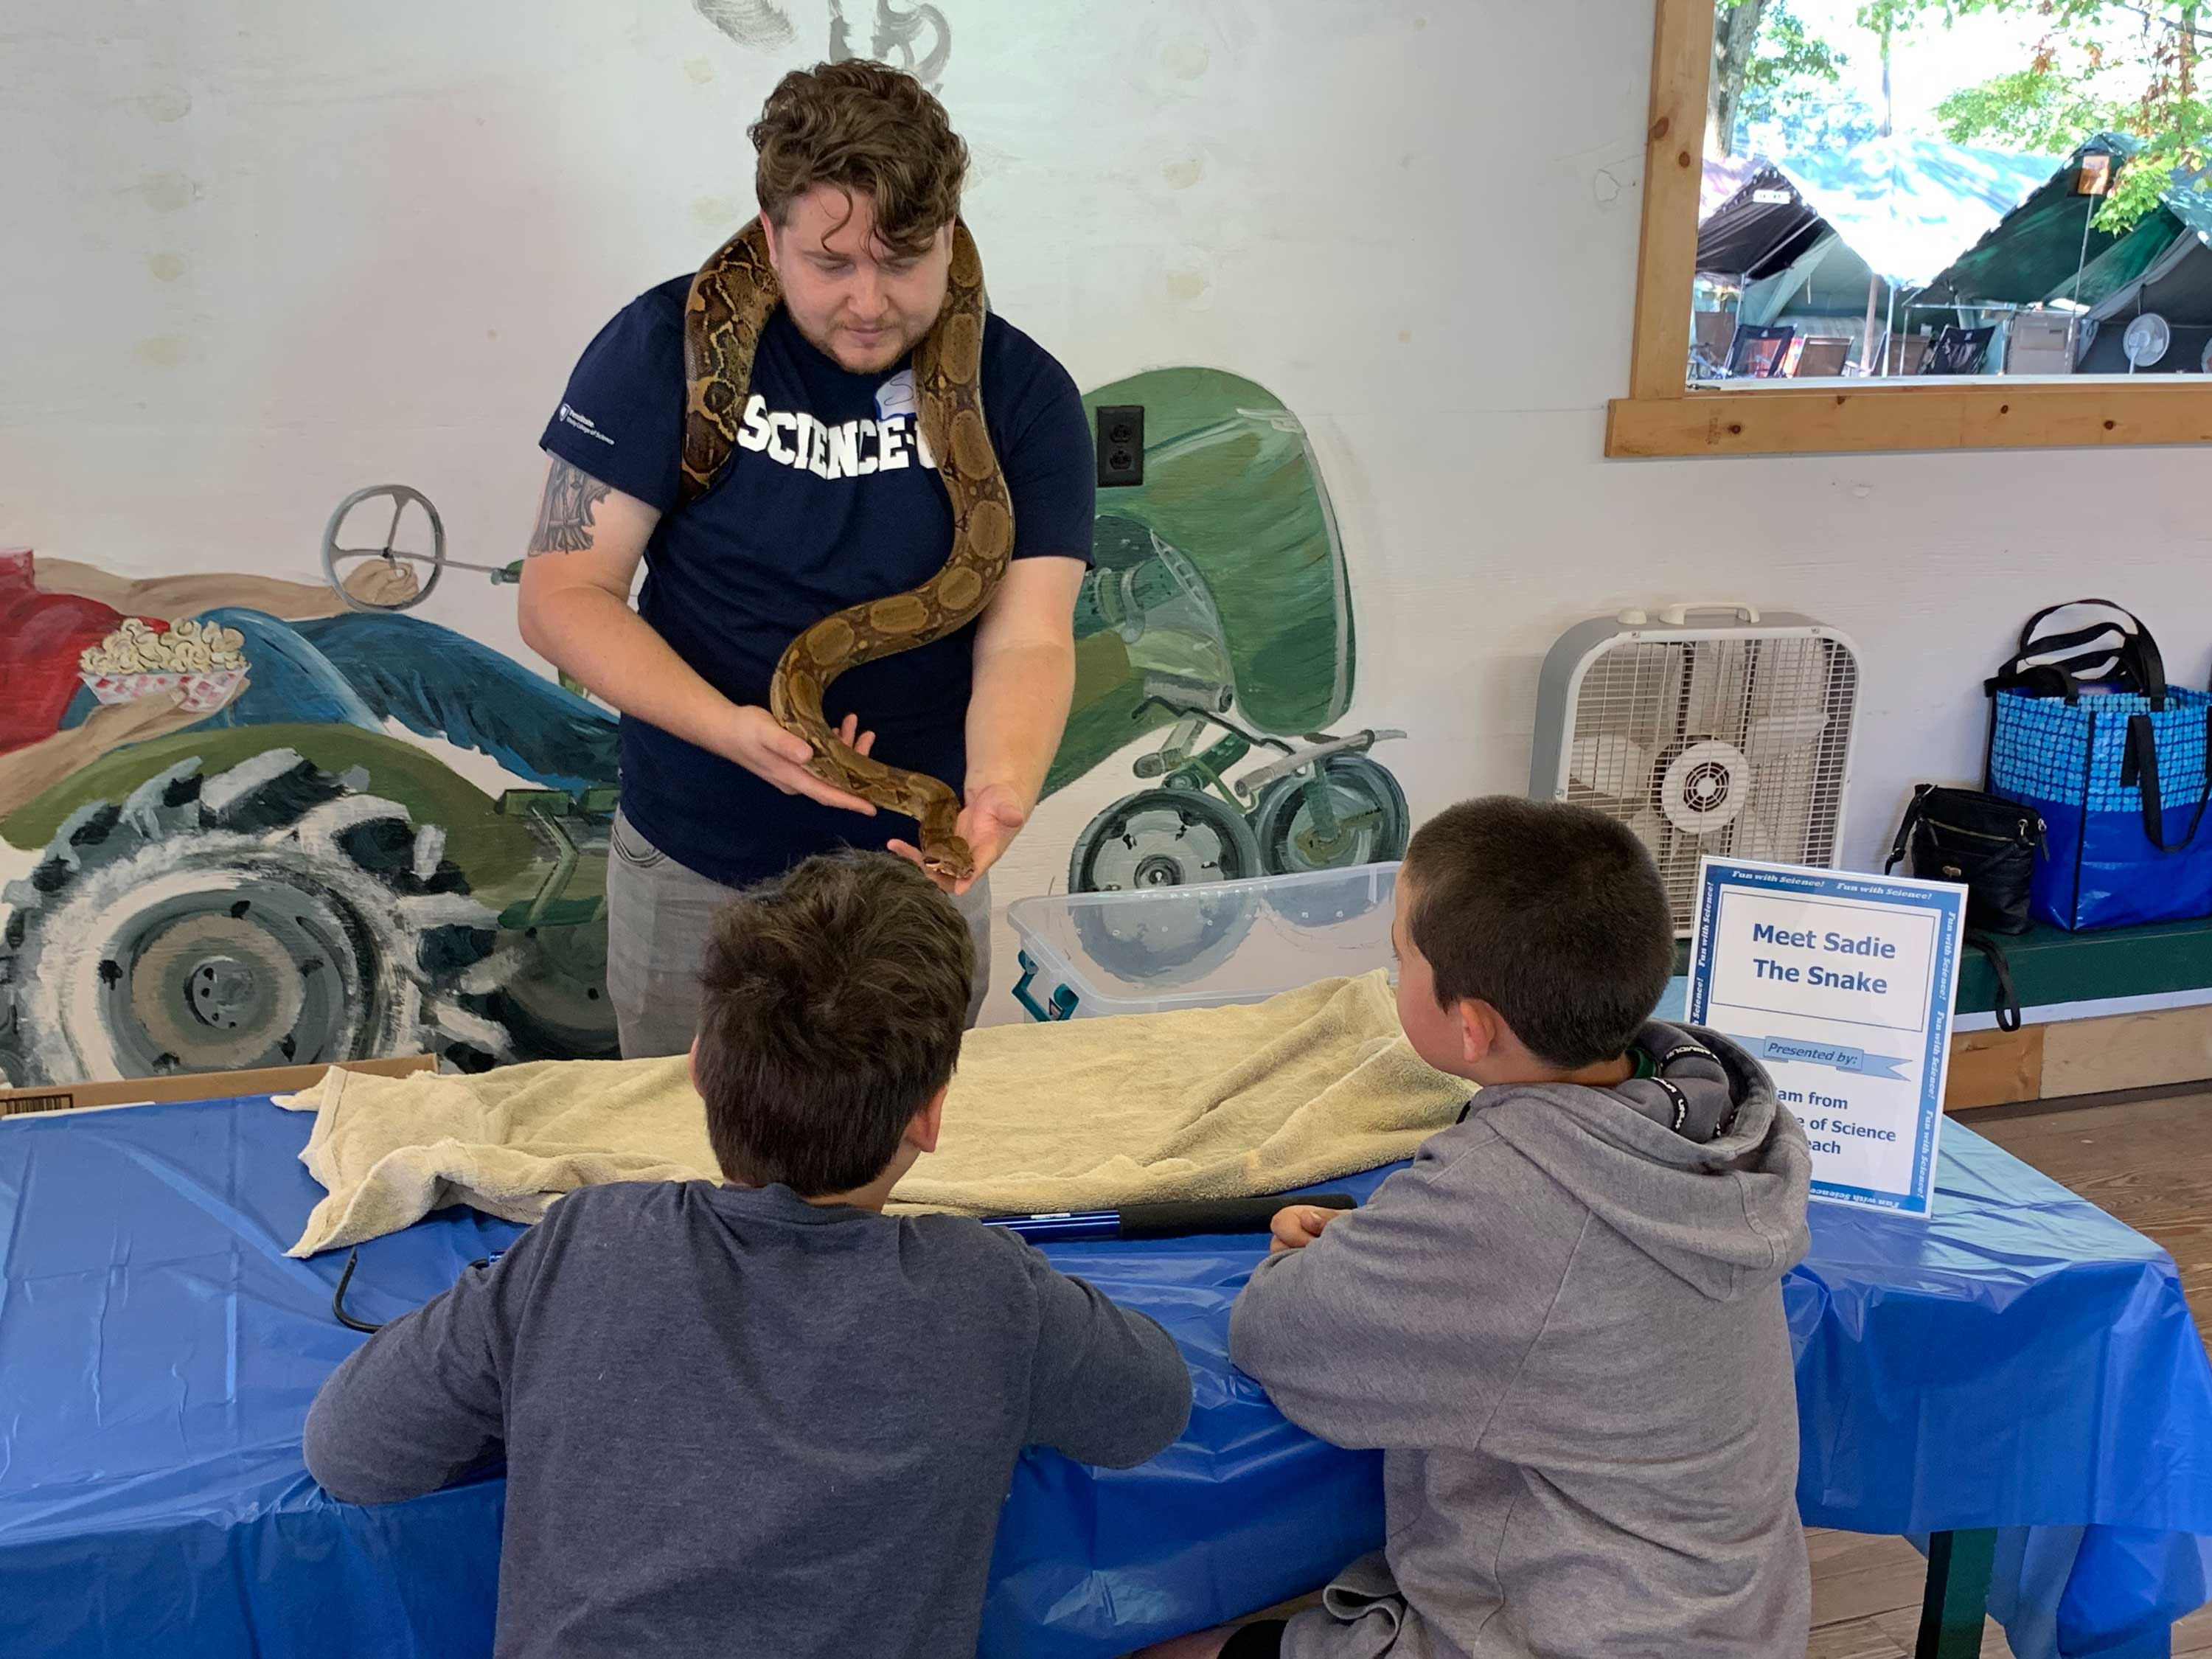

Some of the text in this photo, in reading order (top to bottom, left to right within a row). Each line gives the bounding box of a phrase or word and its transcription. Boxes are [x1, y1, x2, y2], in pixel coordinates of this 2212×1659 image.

[1732, 871, 1826, 888] Fun with Science!
[1836, 883, 1933, 900] Fun with Science!
[1698, 882, 1714, 967] Fun with Science!
[1753, 923, 1896, 959] Meet Sadie
[1939, 911, 1956, 1001] Fun with Science!
[1753, 959, 1888, 994] The Snake
[1692, 977, 1704, 1019] Science!
[1767, 1042, 1858, 1065] Presented by:
[1928, 1010, 1945, 1100] Fun with Science!
[1777, 1089, 1848, 1110] am from
[1809, 1118, 1829, 1131] of
[1831, 1120, 1896, 1142] Science
[1917, 1109, 1933, 1199] Fun with Science!
[1853, 1194, 1877, 1203] with
[1879, 1200, 1900, 1209] Fun
